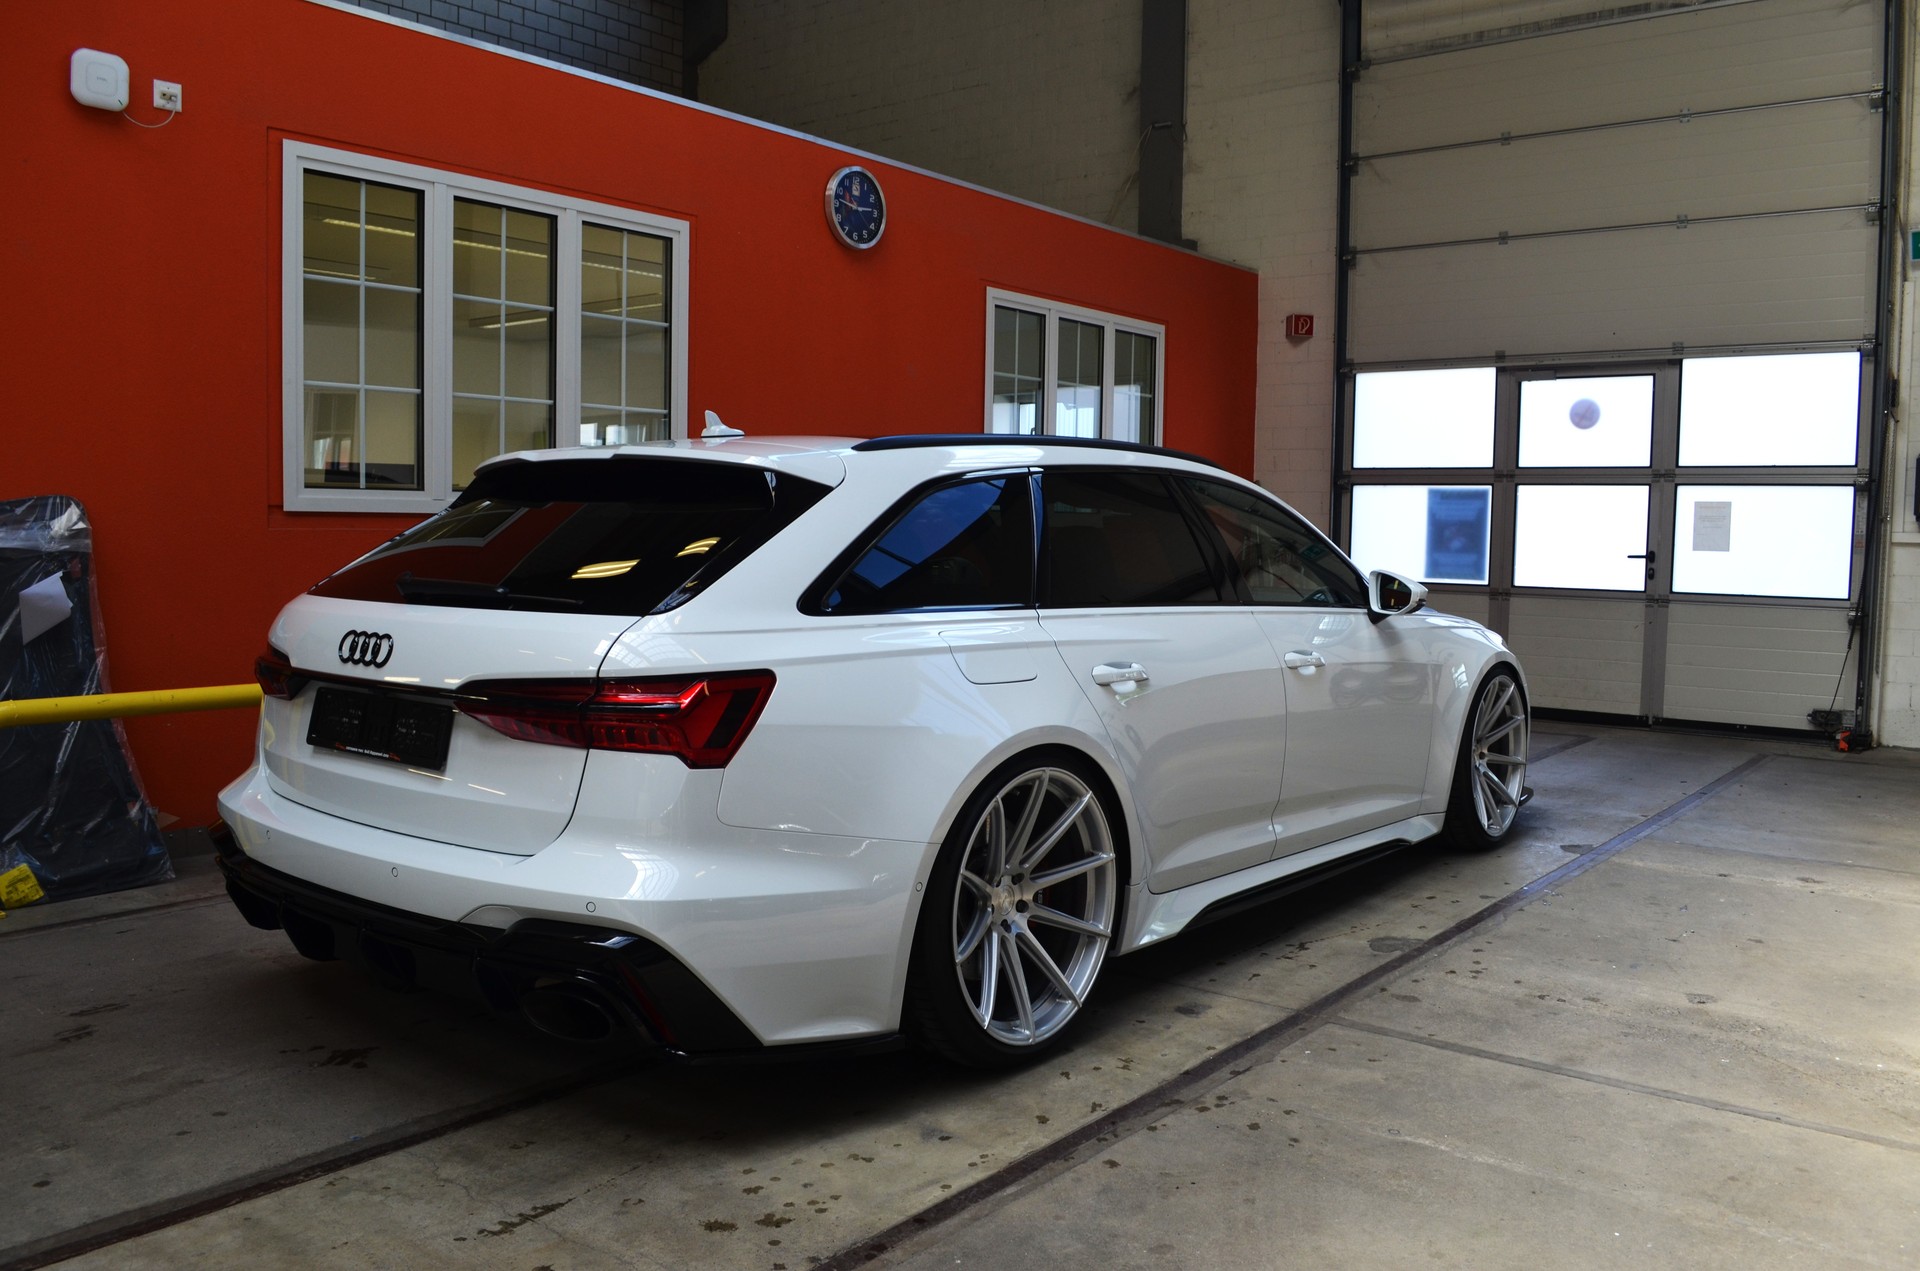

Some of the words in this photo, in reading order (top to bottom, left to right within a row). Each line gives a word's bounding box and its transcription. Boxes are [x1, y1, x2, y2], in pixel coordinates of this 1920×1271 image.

[844, 178, 849, 186] 11
[852, 176, 860, 184] 12
[836, 187, 843, 195] 10
[869, 194, 875, 203] 2
[834, 199, 840, 208] 9
[872, 209, 878, 217] 3
[836, 213, 842, 222] 8
[843, 226, 849, 234] 7
[869, 222, 875, 230] 4
[853, 232, 858, 241] 6
[862, 230, 868, 238] 5
